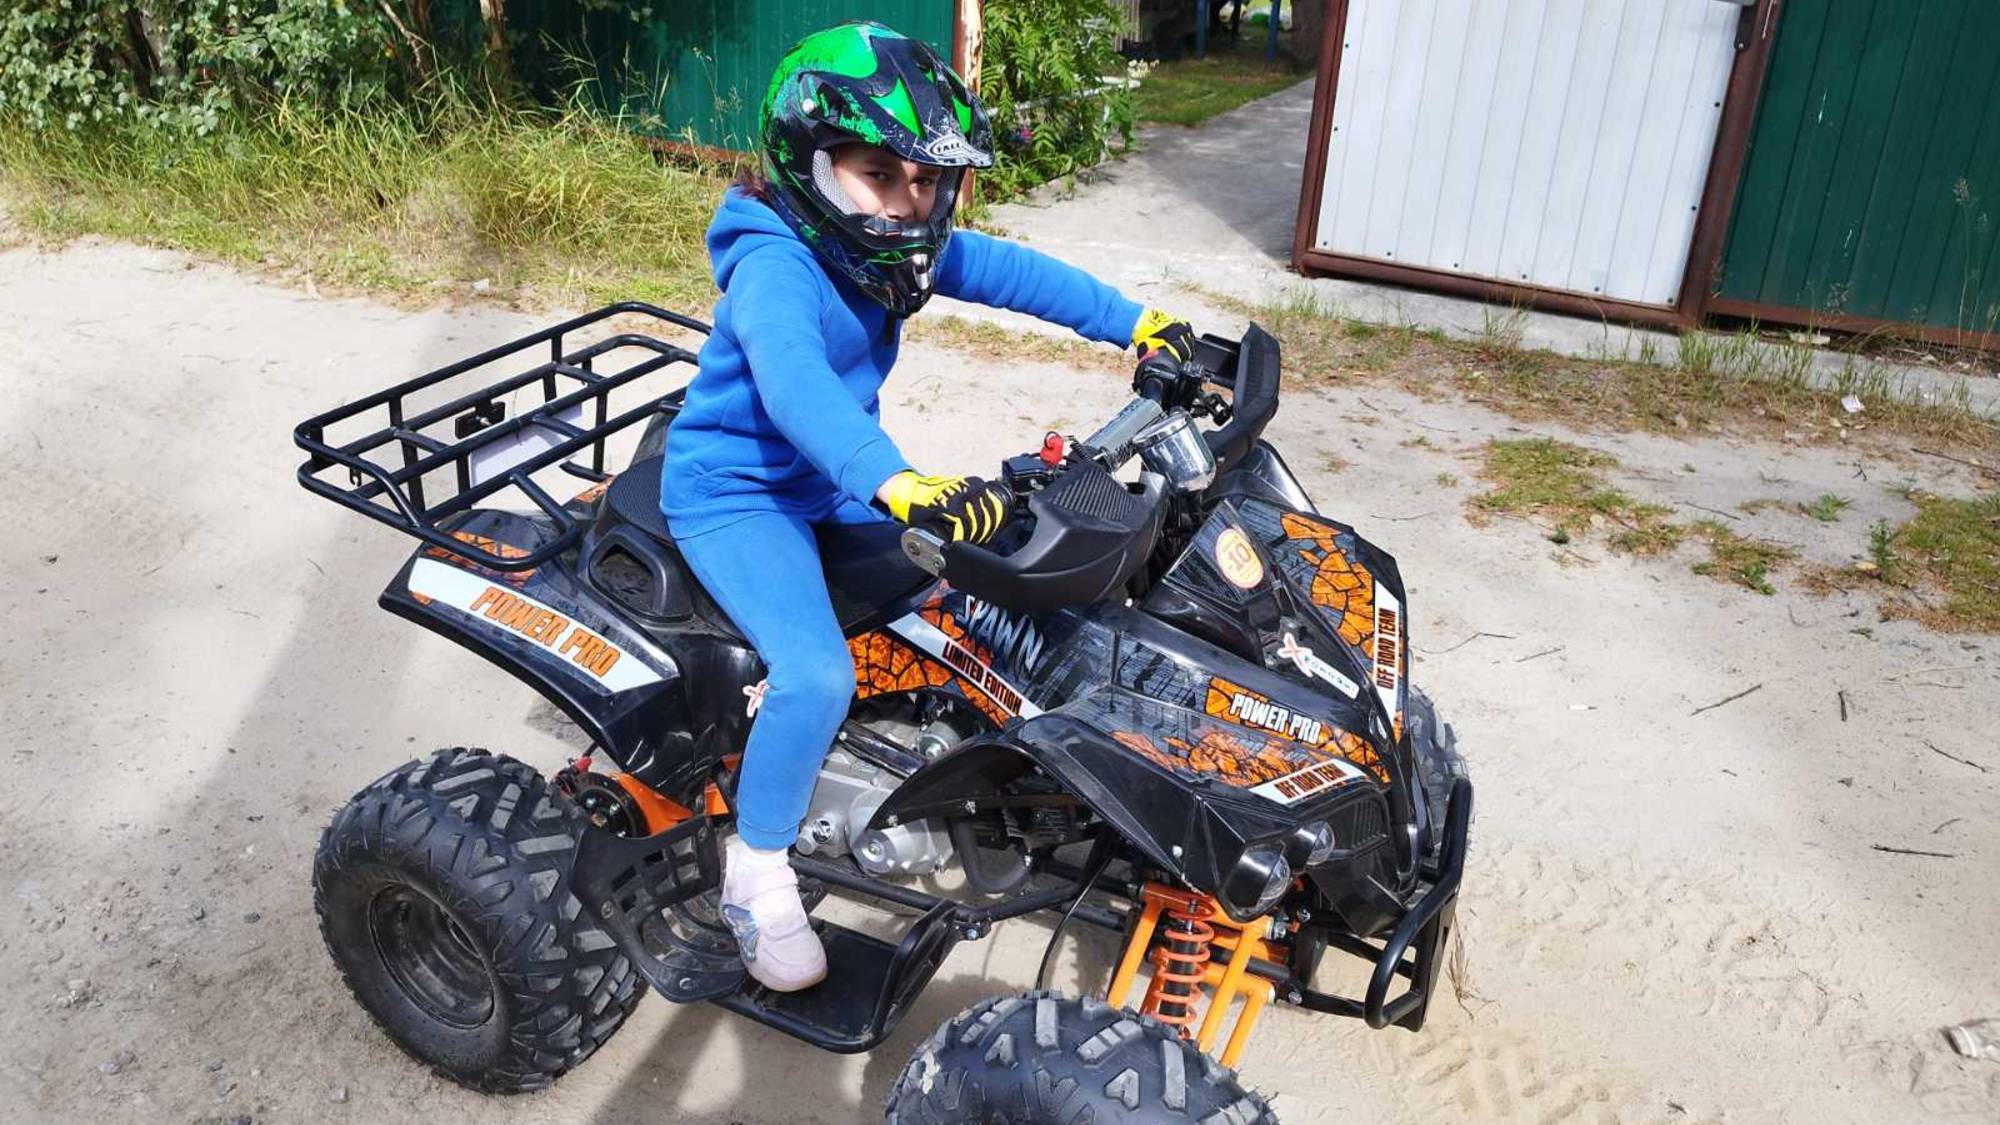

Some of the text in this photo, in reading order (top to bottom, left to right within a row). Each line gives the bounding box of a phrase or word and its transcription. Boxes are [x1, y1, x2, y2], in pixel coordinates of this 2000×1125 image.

[470, 586, 621, 678] POWER PRO
[1376, 607, 1396, 690] OFF ROAD TEAM
[942, 640, 1023, 716] LIMITED EDITION
[1229, 693, 1322, 745] POWER PRO
[1273, 762, 1348, 800] OFF ROAD TEAM
